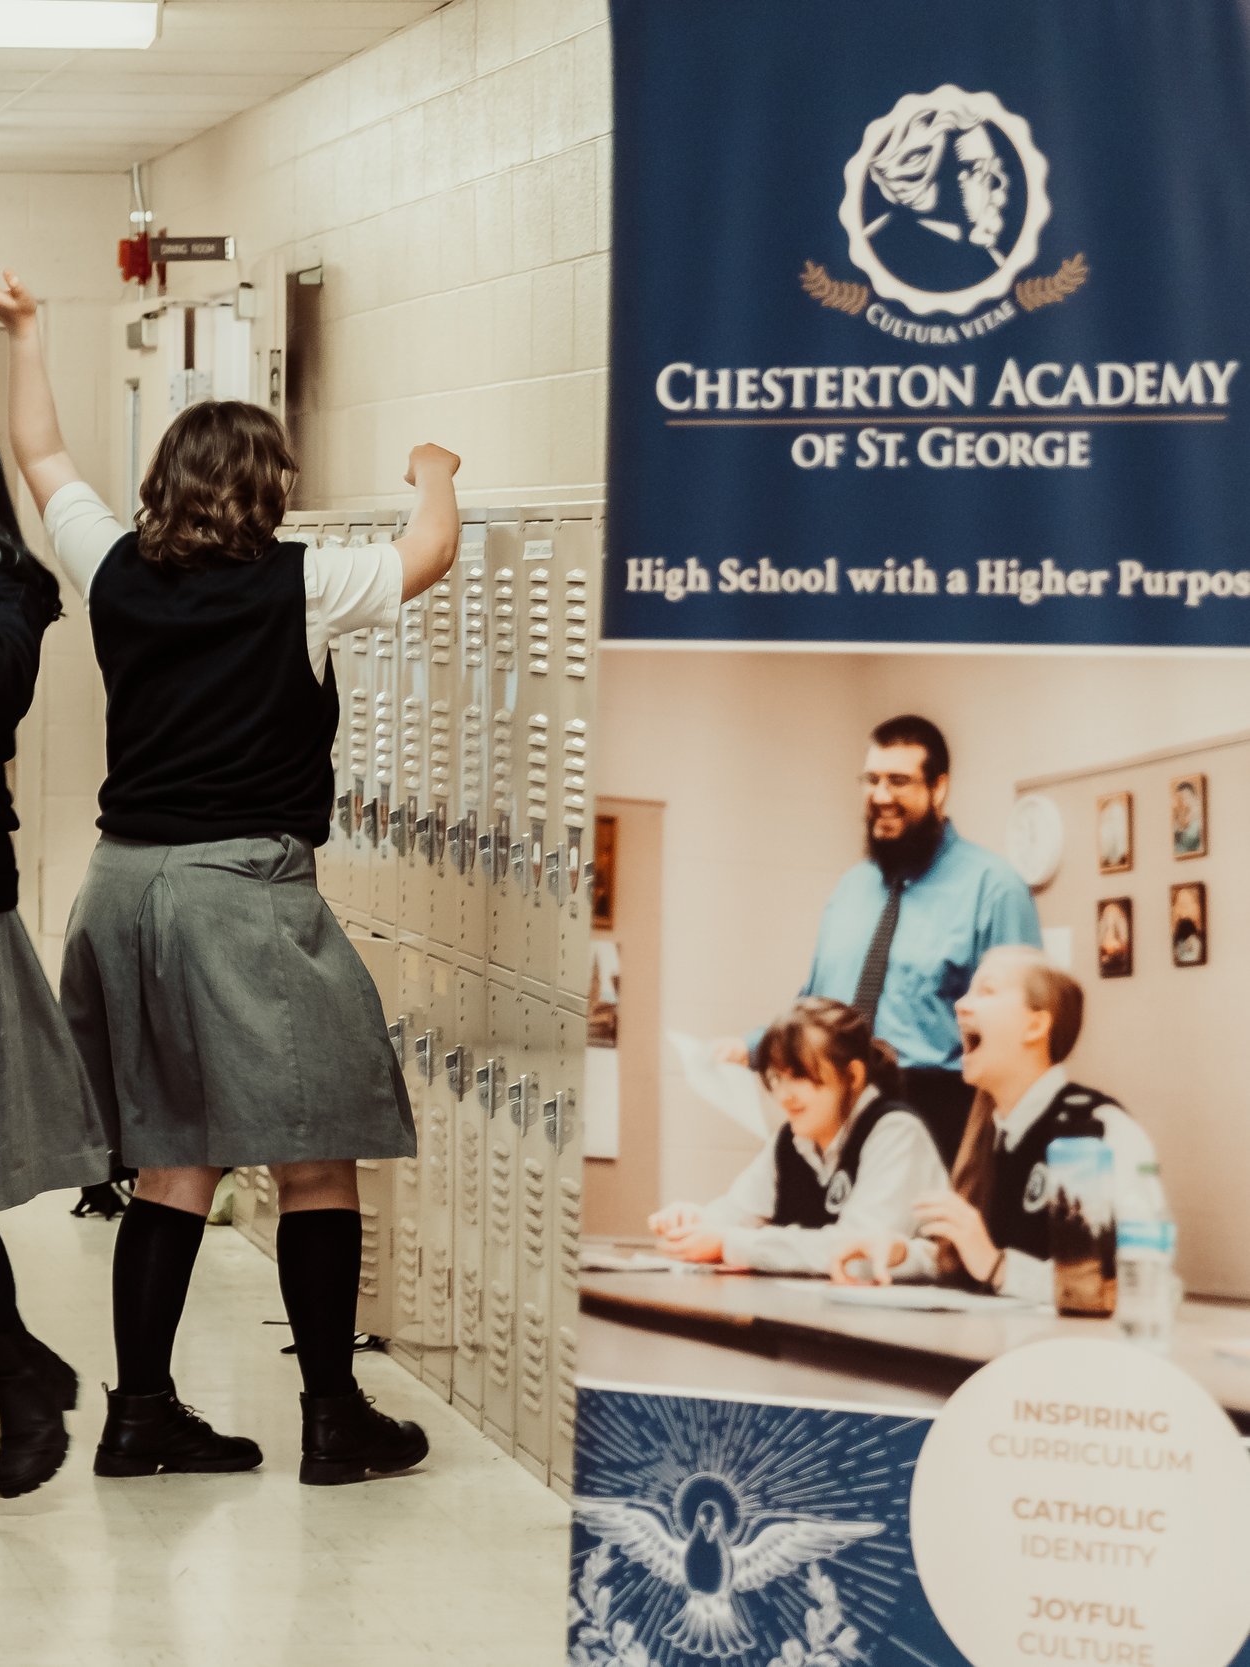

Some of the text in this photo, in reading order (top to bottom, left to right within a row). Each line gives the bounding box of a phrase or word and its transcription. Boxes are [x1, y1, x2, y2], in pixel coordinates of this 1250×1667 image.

[866, 300, 1016, 344] CULTURA VITAE
[655, 358, 1239, 412] CHESTERTON ACADEMY
[790, 426, 1092, 469] OF ST. GEORGE
[625, 556, 711, 602] High
[718, 557, 839, 594] School
[845, 557, 938, 595] with
[945, 568, 969, 595] a
[975, 558, 1111, 605] Higher
[1012, 1399, 1171, 1434] INSPIRING
[987, 1433, 1194, 1473] CURRICULUM
[1012, 1497, 1167, 1533] CATHOLIC
[1020, 1535, 1157, 1568] IDENTITY
[1028, 1596, 1146, 1630] JOYFUL
[1017, 1631, 1155, 1667] CULTURE
